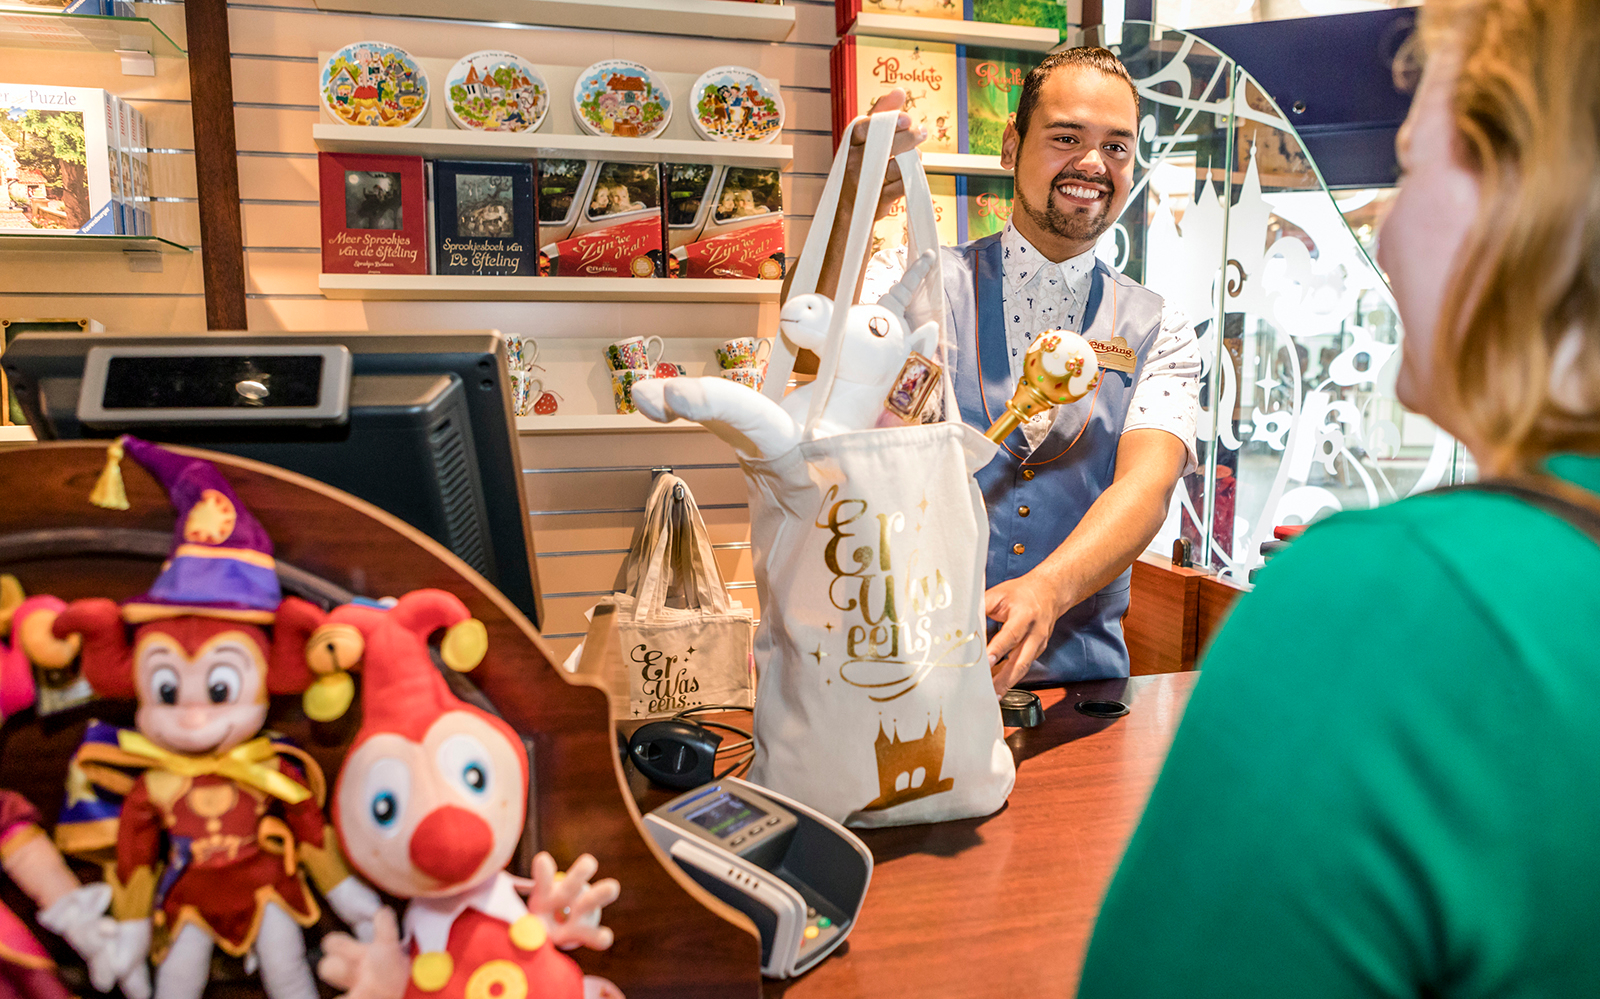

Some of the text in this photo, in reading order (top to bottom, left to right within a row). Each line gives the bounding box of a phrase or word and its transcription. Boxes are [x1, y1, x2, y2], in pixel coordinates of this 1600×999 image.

[872, 56, 943, 91] Pinokkio
[29, 89, 77, 106] Puzzle
[81, 206, 111, 234] Ravensburger
[328, 231, 411, 250] Meer Sprookjes
[338, 245, 358, 256] van
[360, 245, 374, 257] de
[375, 245, 418, 264] Efteling
[442, 237, 523, 256] Sprookjesboek van
[572, 239, 615, 272] Zijn
[449, 252, 520, 274] De Efteling
[700, 241, 740, 274] Zijn
[1088, 341, 1132, 357] Efteling
[815, 484, 905, 577] Er
[829, 548, 953, 625] Was
[631, 644, 678, 681] Er
[642, 668, 699, 700] Was
